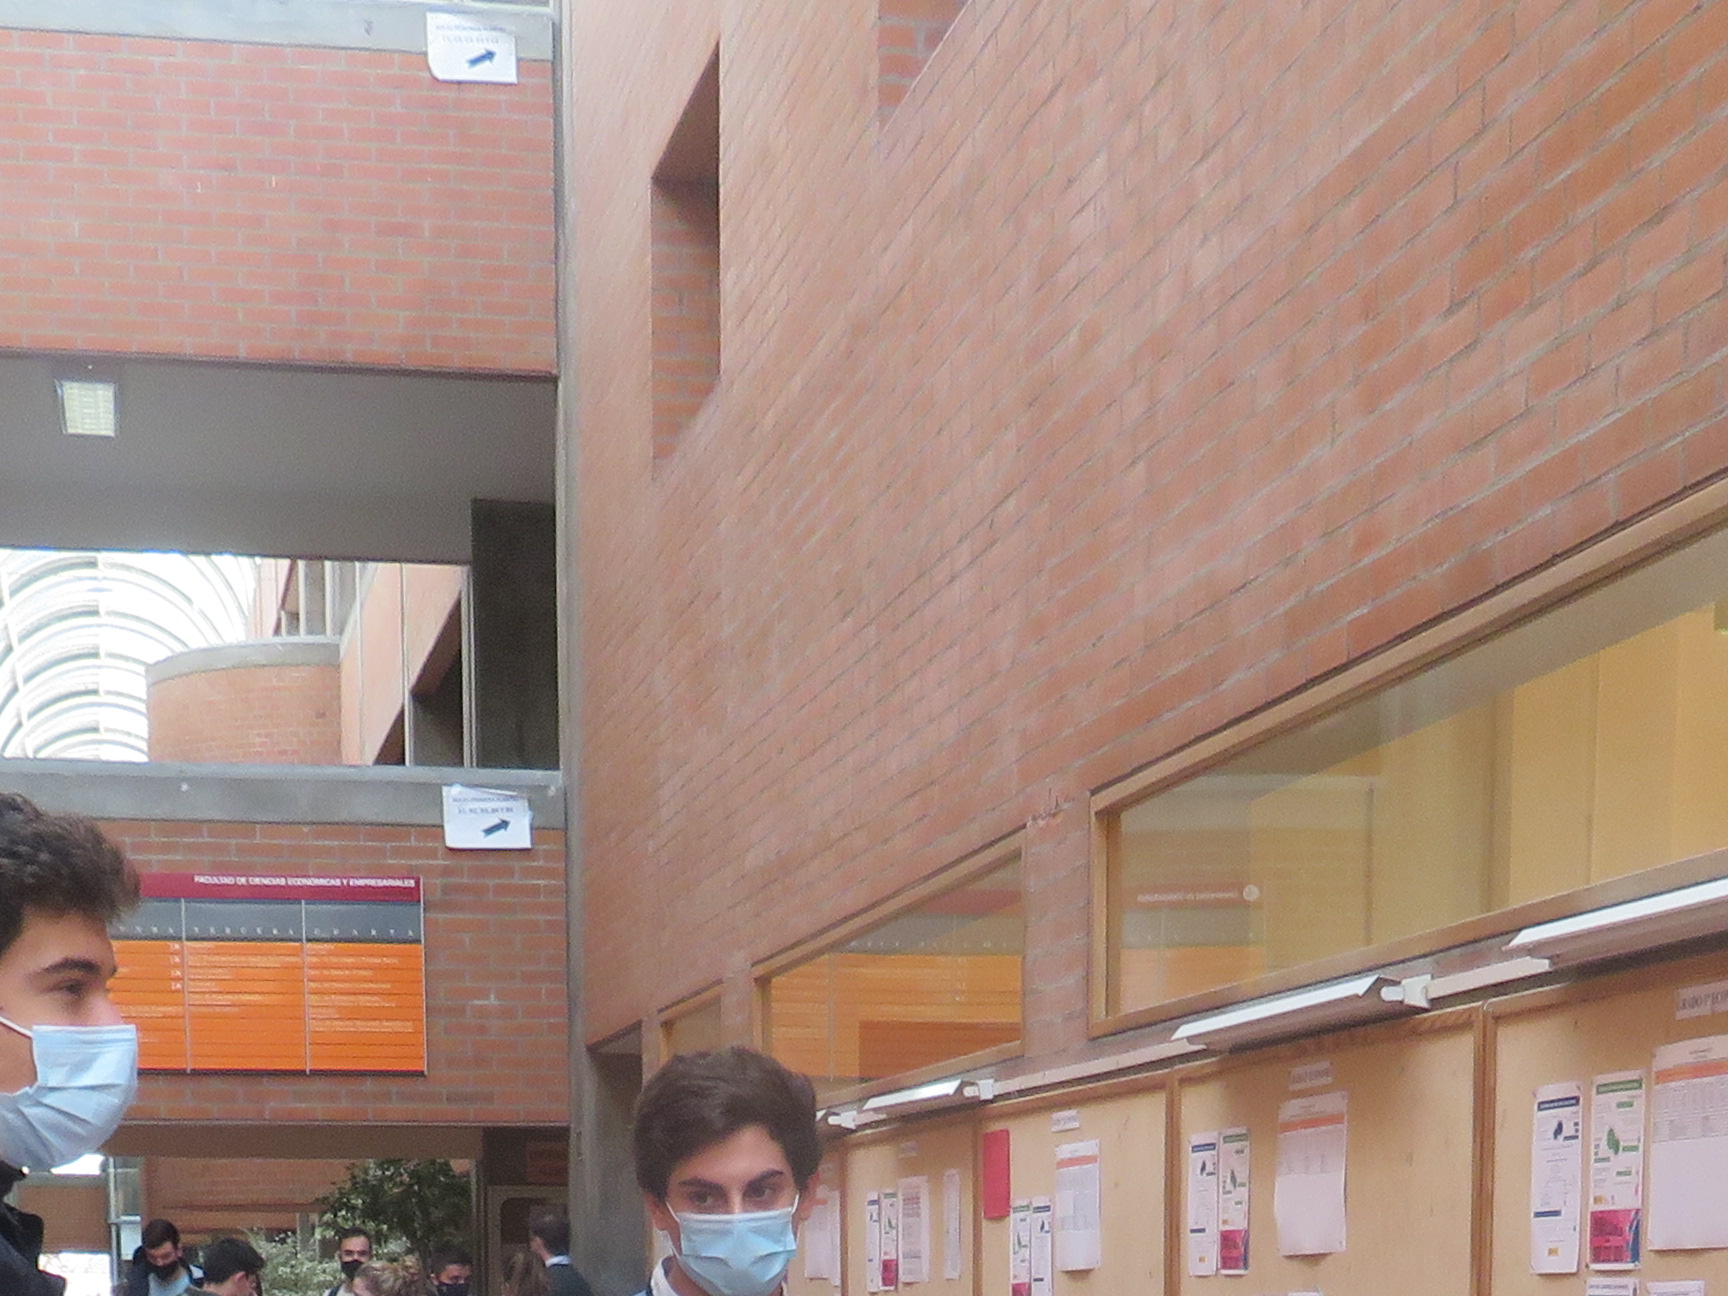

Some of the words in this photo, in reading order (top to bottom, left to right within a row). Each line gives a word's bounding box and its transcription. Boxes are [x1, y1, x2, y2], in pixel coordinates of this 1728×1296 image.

[194, 874, 235, 886] FACULTAD
[236, 876, 247, 886] DE
[248, 876, 286, 887] CIENCIAS
[349, 878, 416, 889] EMPRESARIALES
